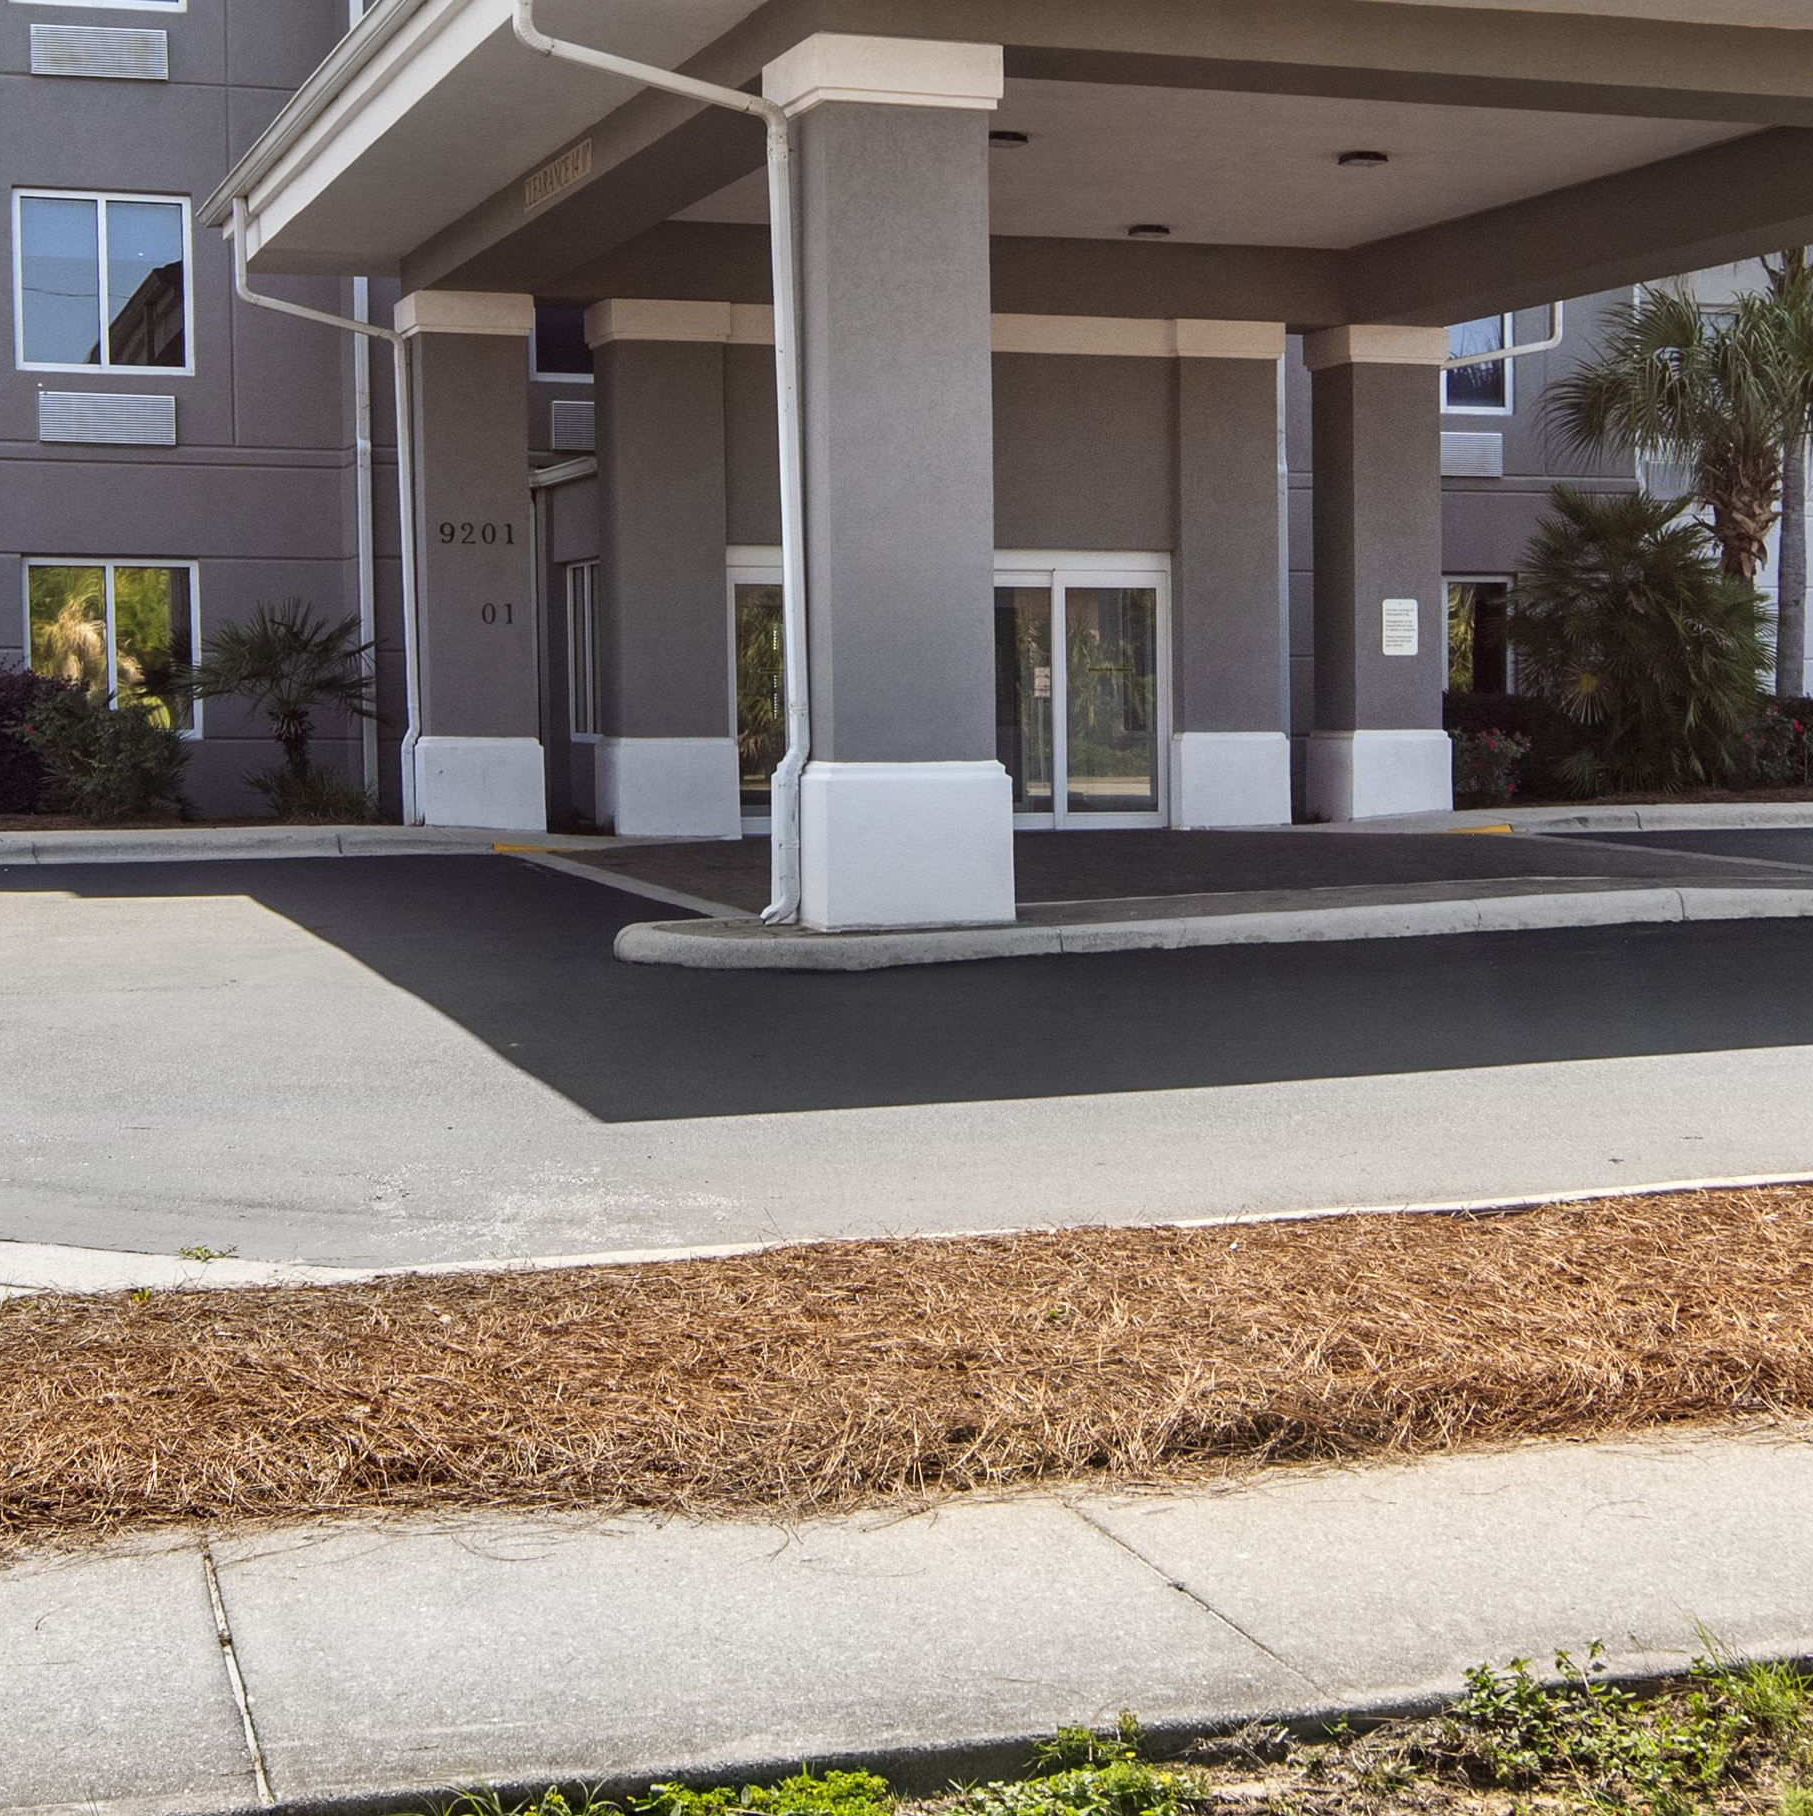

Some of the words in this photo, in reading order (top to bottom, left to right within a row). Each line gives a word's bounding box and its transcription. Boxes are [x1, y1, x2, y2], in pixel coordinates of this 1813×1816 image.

[525, 155, 570, 209] CLEARANCE
[439, 521, 515, 545] 9201
[481, 602, 513, 625] 01
